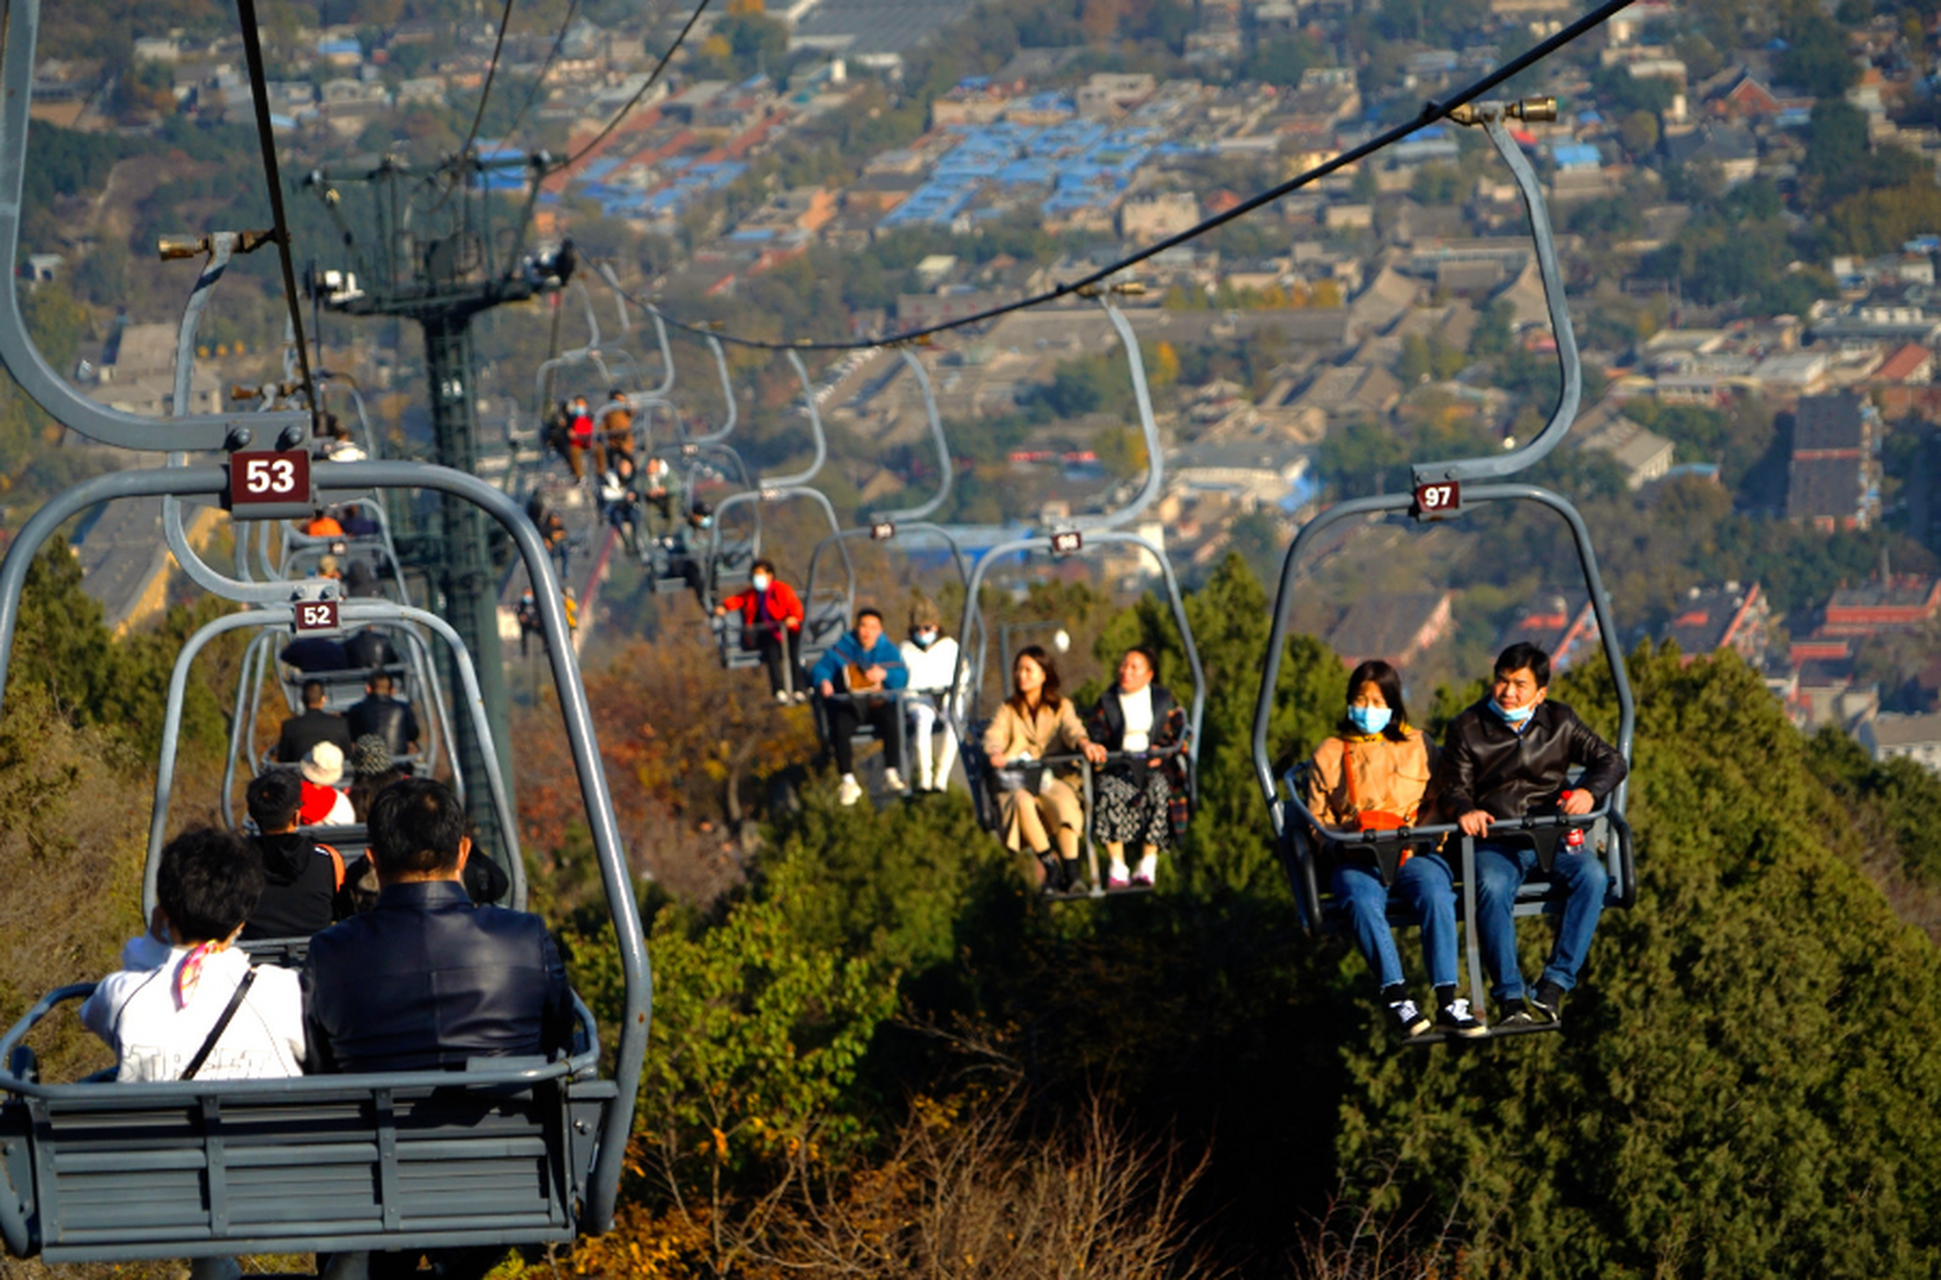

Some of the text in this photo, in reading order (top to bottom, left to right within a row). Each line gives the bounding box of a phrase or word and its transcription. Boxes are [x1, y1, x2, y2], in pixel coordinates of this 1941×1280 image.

[247, 459, 295, 493] 53
[1425, 486, 1452, 507] 97
[304, 605, 331, 625] 52
